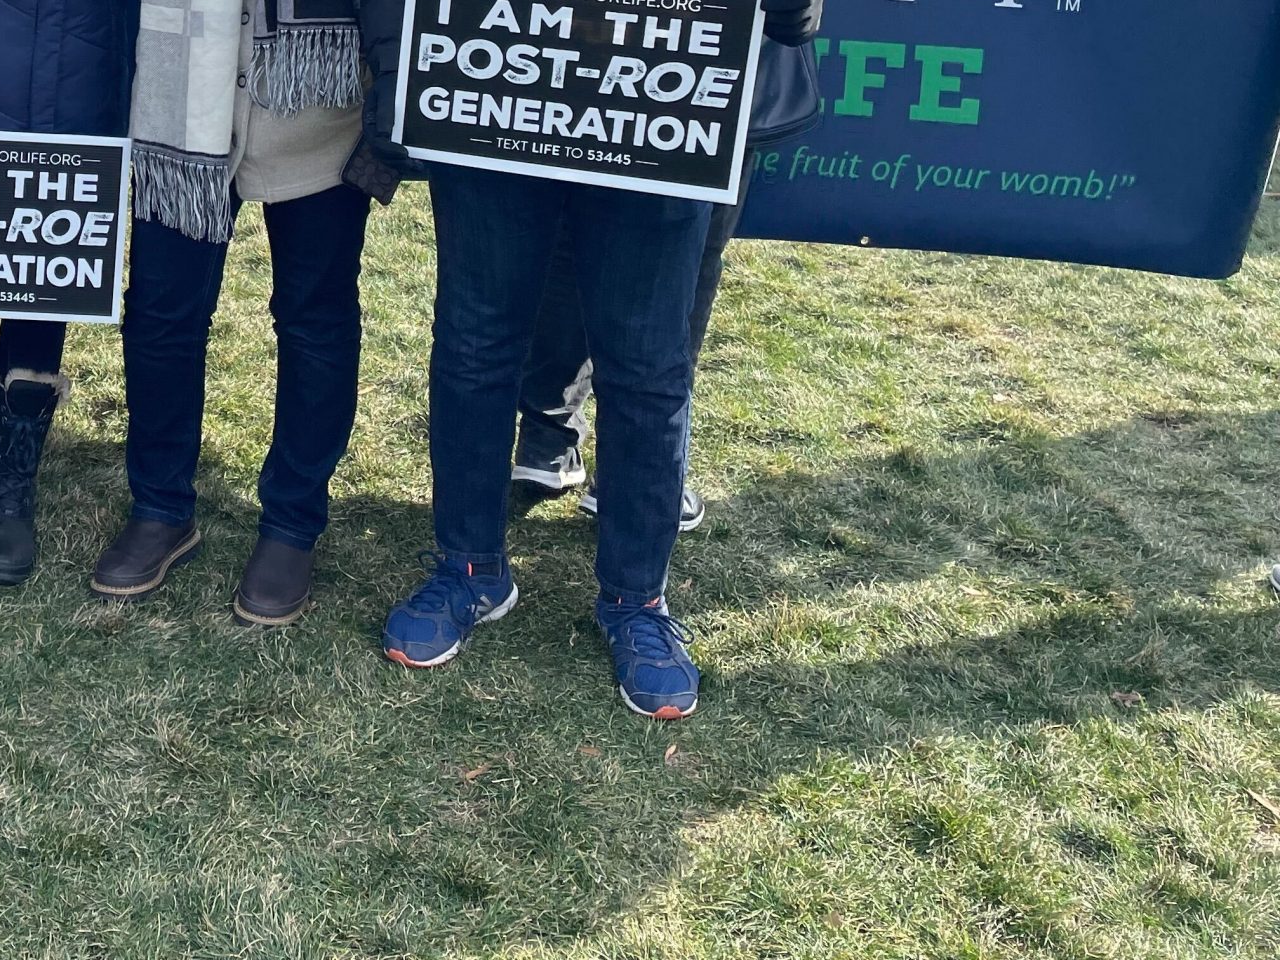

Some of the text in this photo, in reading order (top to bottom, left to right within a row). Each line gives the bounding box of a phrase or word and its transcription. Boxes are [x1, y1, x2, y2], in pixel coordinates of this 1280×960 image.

[479, 0, 574, 39] AM
[604, 11, 723, 56] THE
[418, 32, 741, 108] POST-ROE
[419, 86, 721, 156] GENERATION
[496, 137, 632, 165] TEXT LIFE TO 53445
[789, 145, 863, 180] fruit
[871, 154, 911, 189] of
[915, 164, 992, 192] your
[7, 169, 99, 203] THE
[0, 292, 36, 303] 53445
